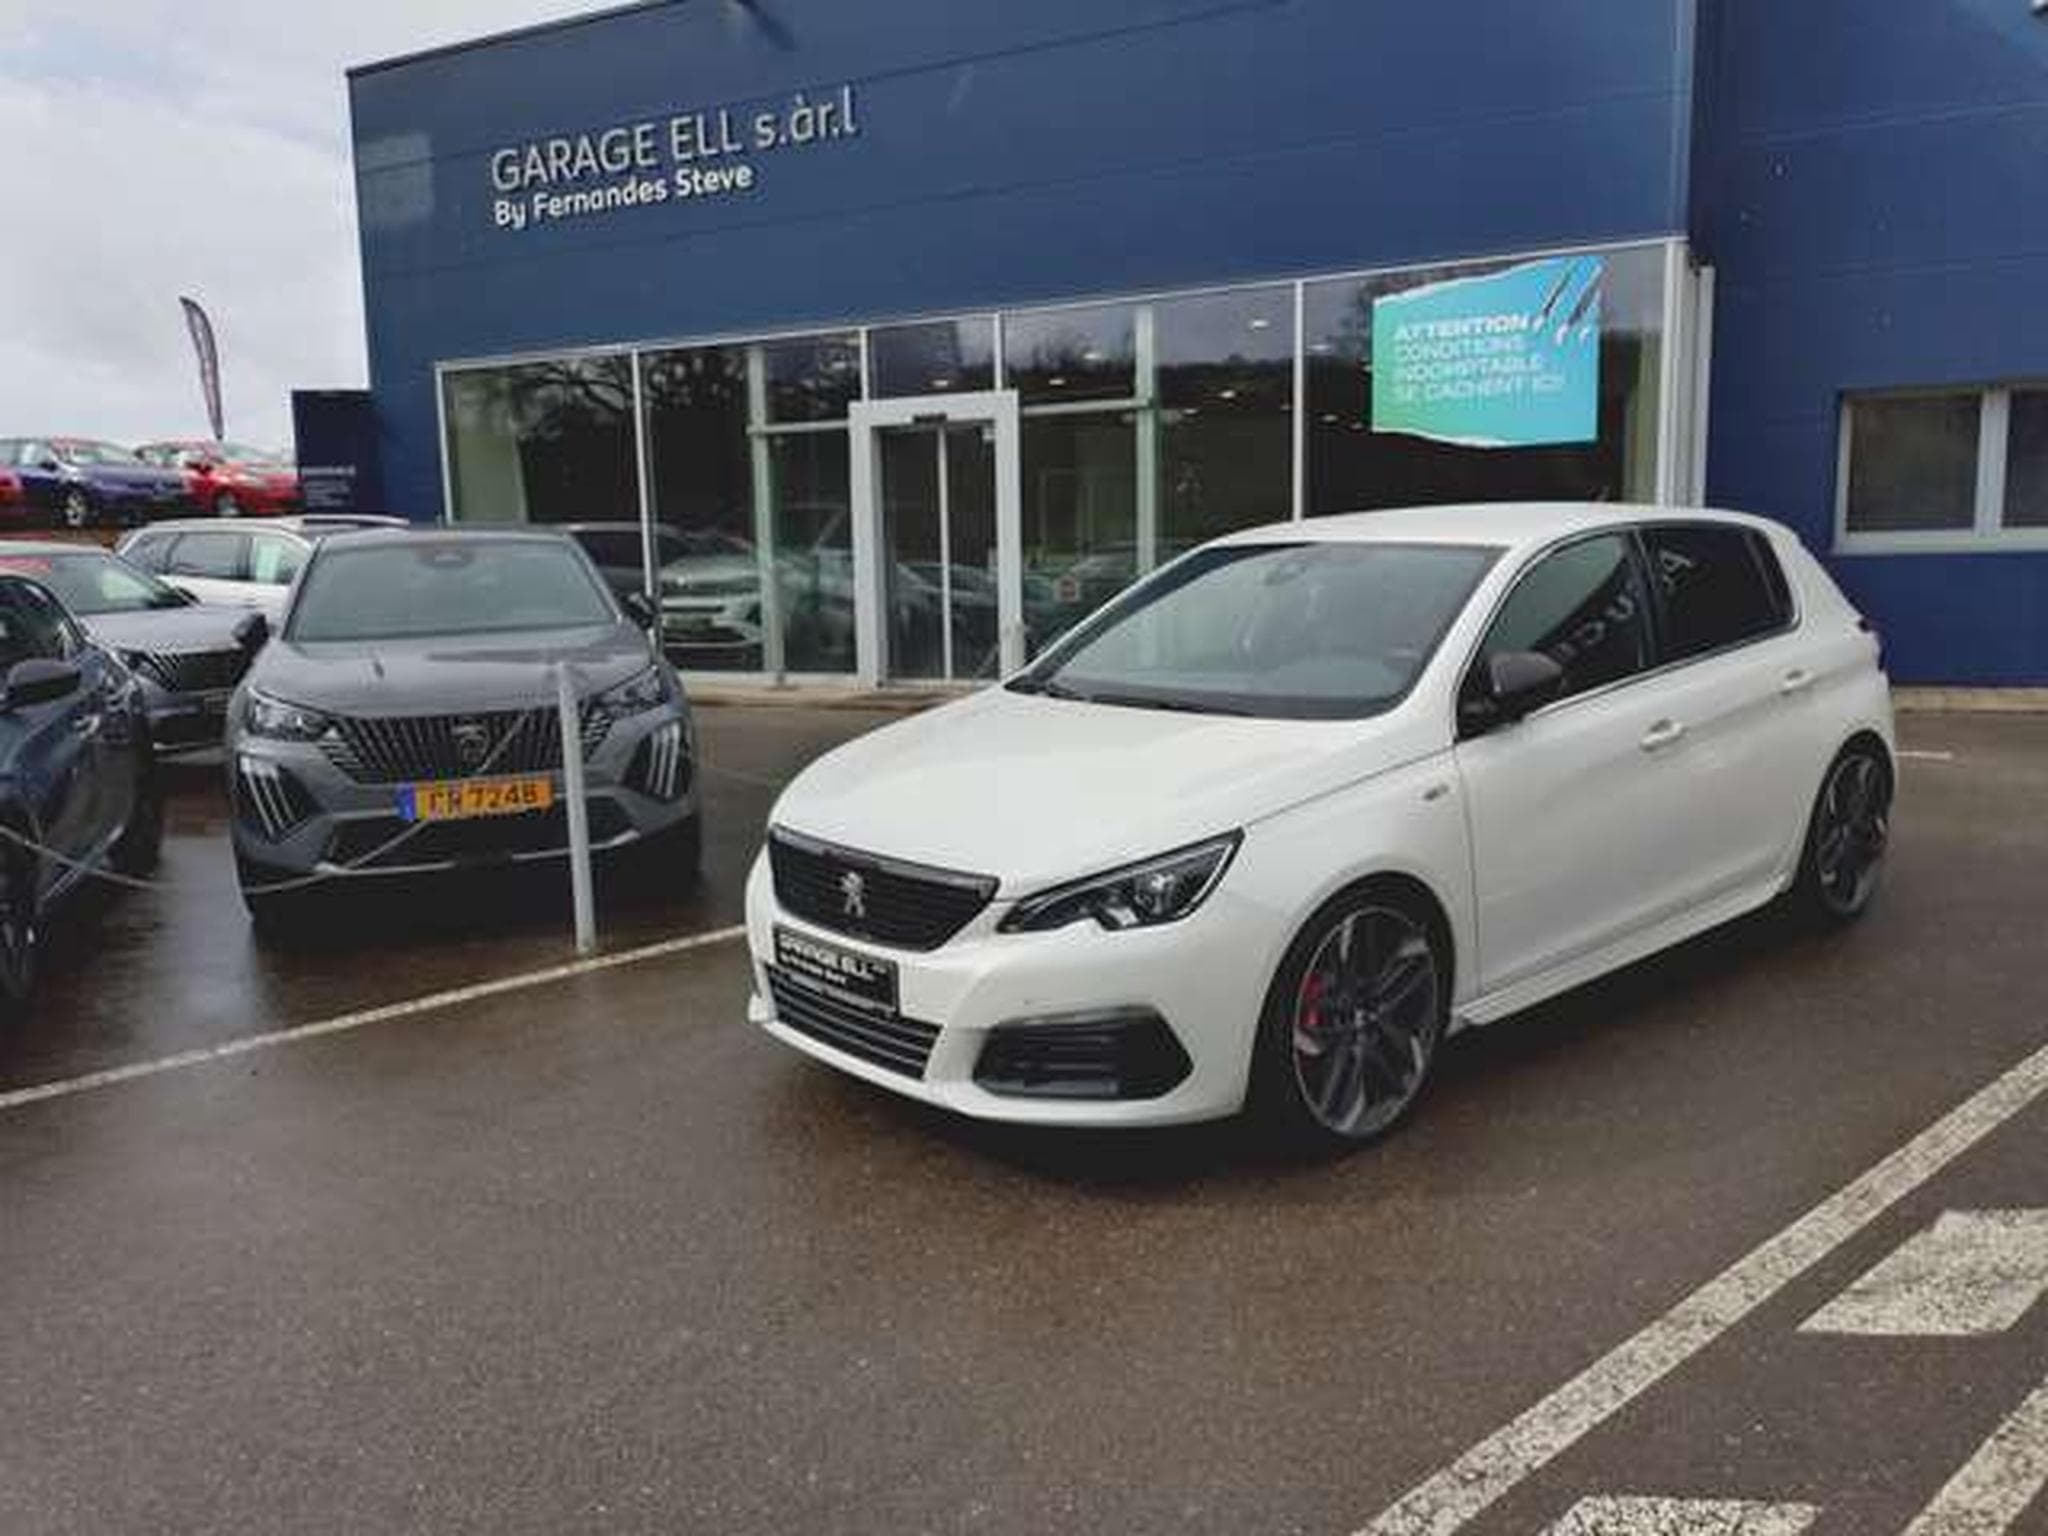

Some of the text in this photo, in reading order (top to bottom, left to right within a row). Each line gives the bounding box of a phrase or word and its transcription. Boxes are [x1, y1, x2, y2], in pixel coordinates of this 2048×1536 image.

[491, 122, 658, 191] GARAGE
[670, 109, 743, 161] ELL
[494, 164, 753, 230] By Fernandes Steve
